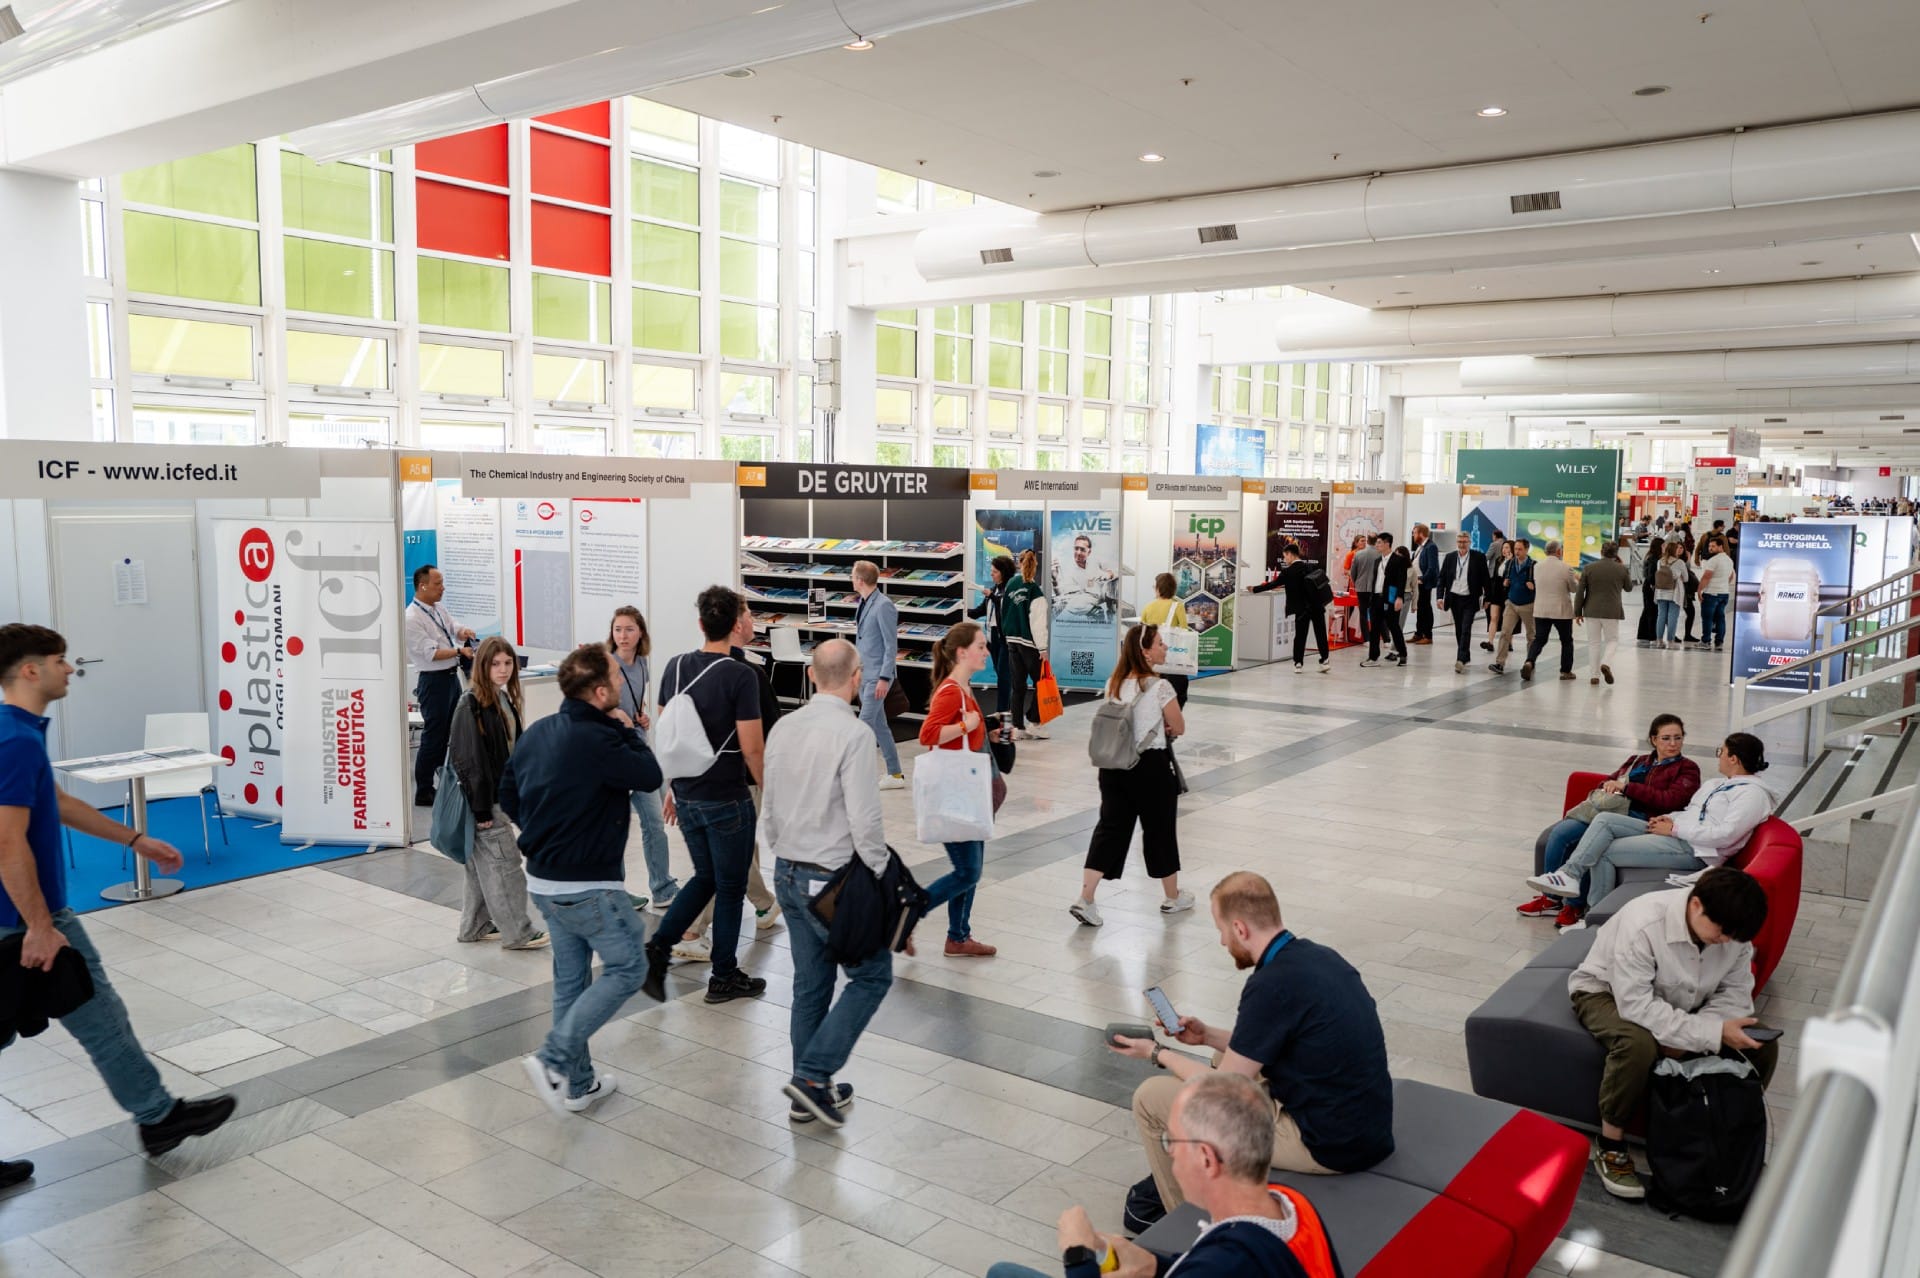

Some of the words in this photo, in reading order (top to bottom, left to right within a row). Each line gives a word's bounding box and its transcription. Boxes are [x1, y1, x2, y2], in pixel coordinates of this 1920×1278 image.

[38, 460, 79, 479] ICF
[103, 462, 238, 481] www.icfed.it
[470, 469, 487, 479] The
[488, 469, 528, 480] Chemical
[530, 470, 563, 482] Industry
[565, 472, 580, 481] and
[581, 472, 626, 484] Engineering
[628, 473, 654, 485] Society
[656, 474, 664, 484] of
[665, 474, 685, 484] China
[798, 469, 828, 494] DE
[834, 470, 929, 494] GRUYTER
[1024, 479, 1040, 491] AWE
[1040, 480, 1079, 492] International
[1556, 492, 1592, 501] Chemistry
[1581, 498, 1608, 506] application
[1060, 518, 1112, 531] AWE
[1189, 513, 1225, 539] icp
[1757, 540, 1795, 549] SAFETY
[1795, 541, 1832, 550] SHIELD.
[1762, 532, 1782, 541] THE
[1783, 533, 1828, 542] ORIGINAL
[285, 529, 383, 670] icf
[1777, 591, 1805, 600] RAMCO
[236, 540, 281, 757] plastica
[1751, 645, 1769, 653] HALL
[336, 688, 349, 701] E
[321, 687, 337, 785] INDUSTRIA
[336, 706, 351, 787] CHIMICA
[350, 688, 367, 830] FARMACEUTICA
[250, 760, 264, 776] la
